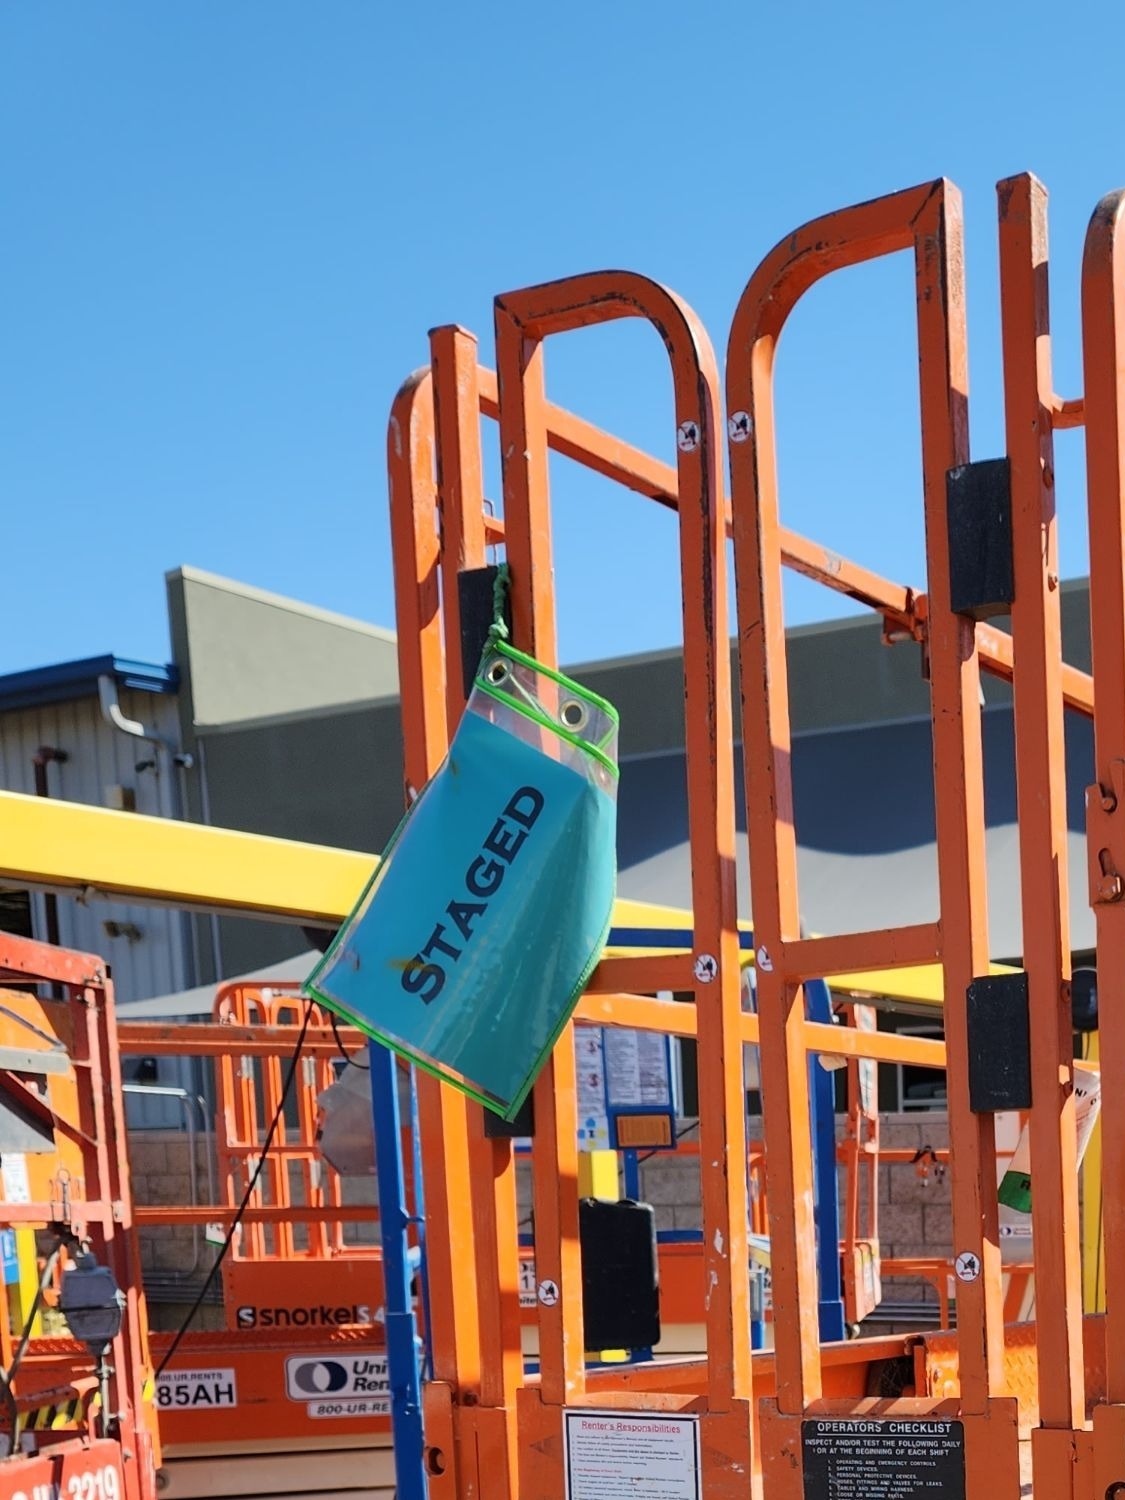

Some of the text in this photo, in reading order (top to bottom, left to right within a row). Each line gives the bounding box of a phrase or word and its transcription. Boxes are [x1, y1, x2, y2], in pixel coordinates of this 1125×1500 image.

[401, 786, 545, 1006] STAGED
[259, 1305, 358, 1326] snorkel
[581, 1421, 681, 1433] Renter's Responsibilities
[817, 1422, 952, 1433] OPERATORS CHECKLIST
